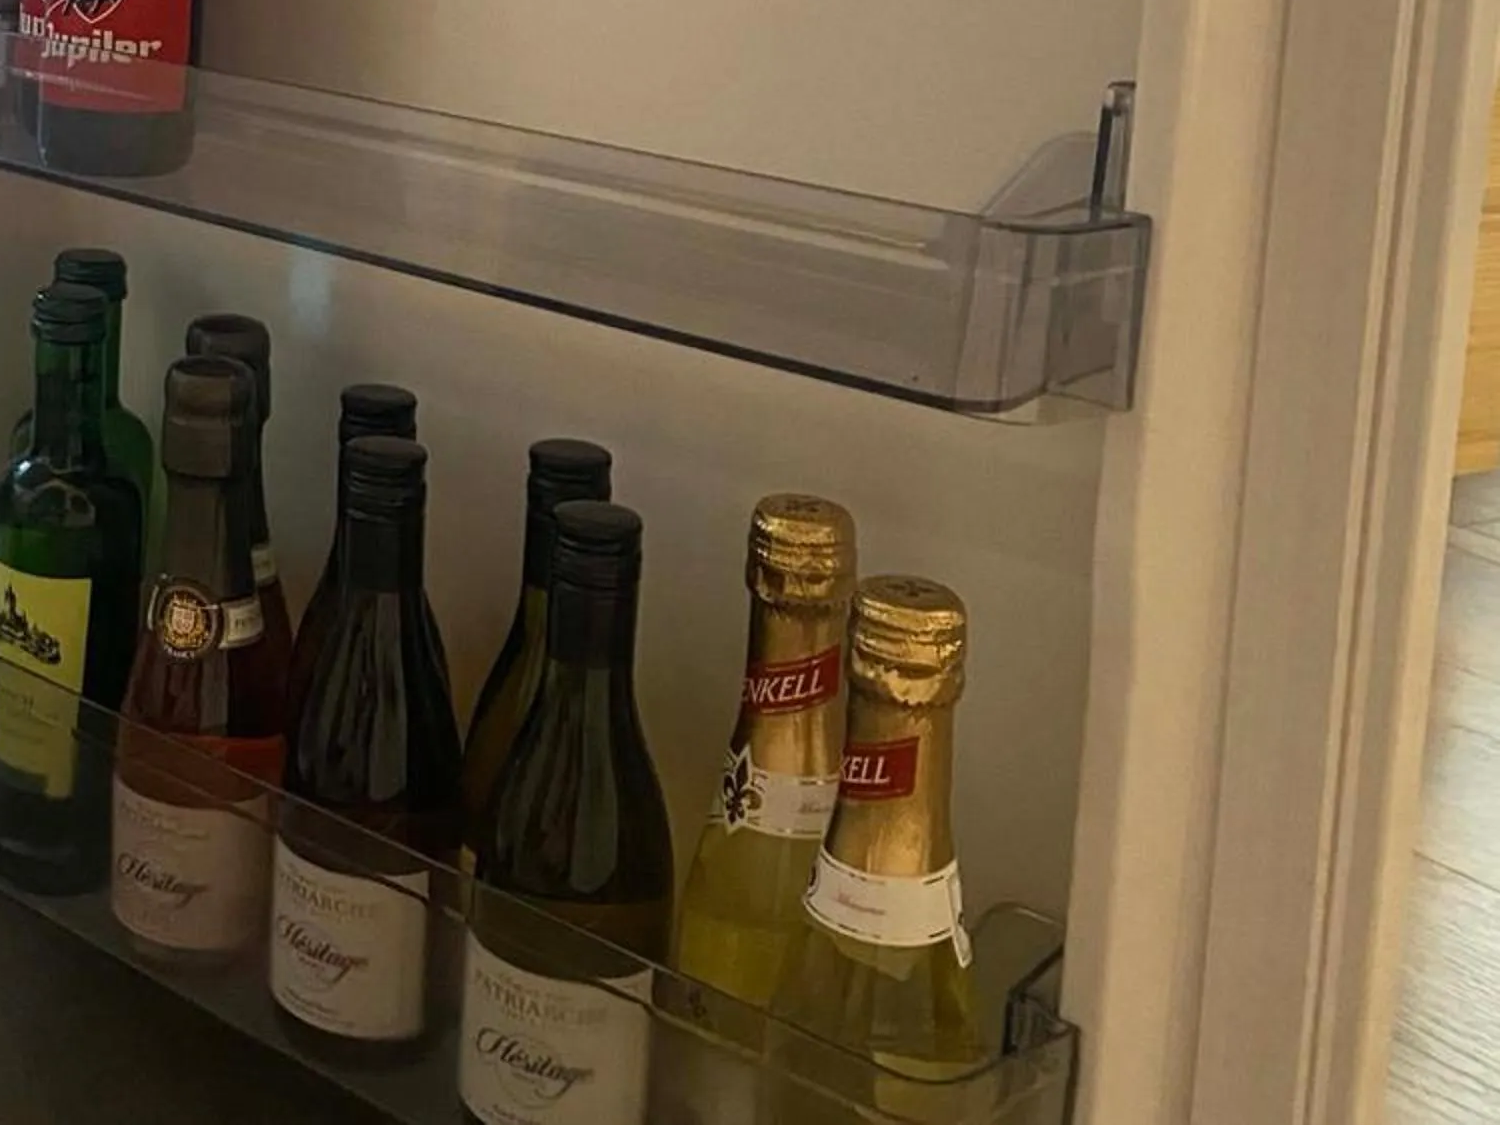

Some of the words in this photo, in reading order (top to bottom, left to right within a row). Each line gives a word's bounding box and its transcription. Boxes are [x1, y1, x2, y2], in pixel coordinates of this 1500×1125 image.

[41, 22, 162, 70] Jupiler
[743, 668, 824, 704] ENKELL
[840, 756, 892, 784] KELL
